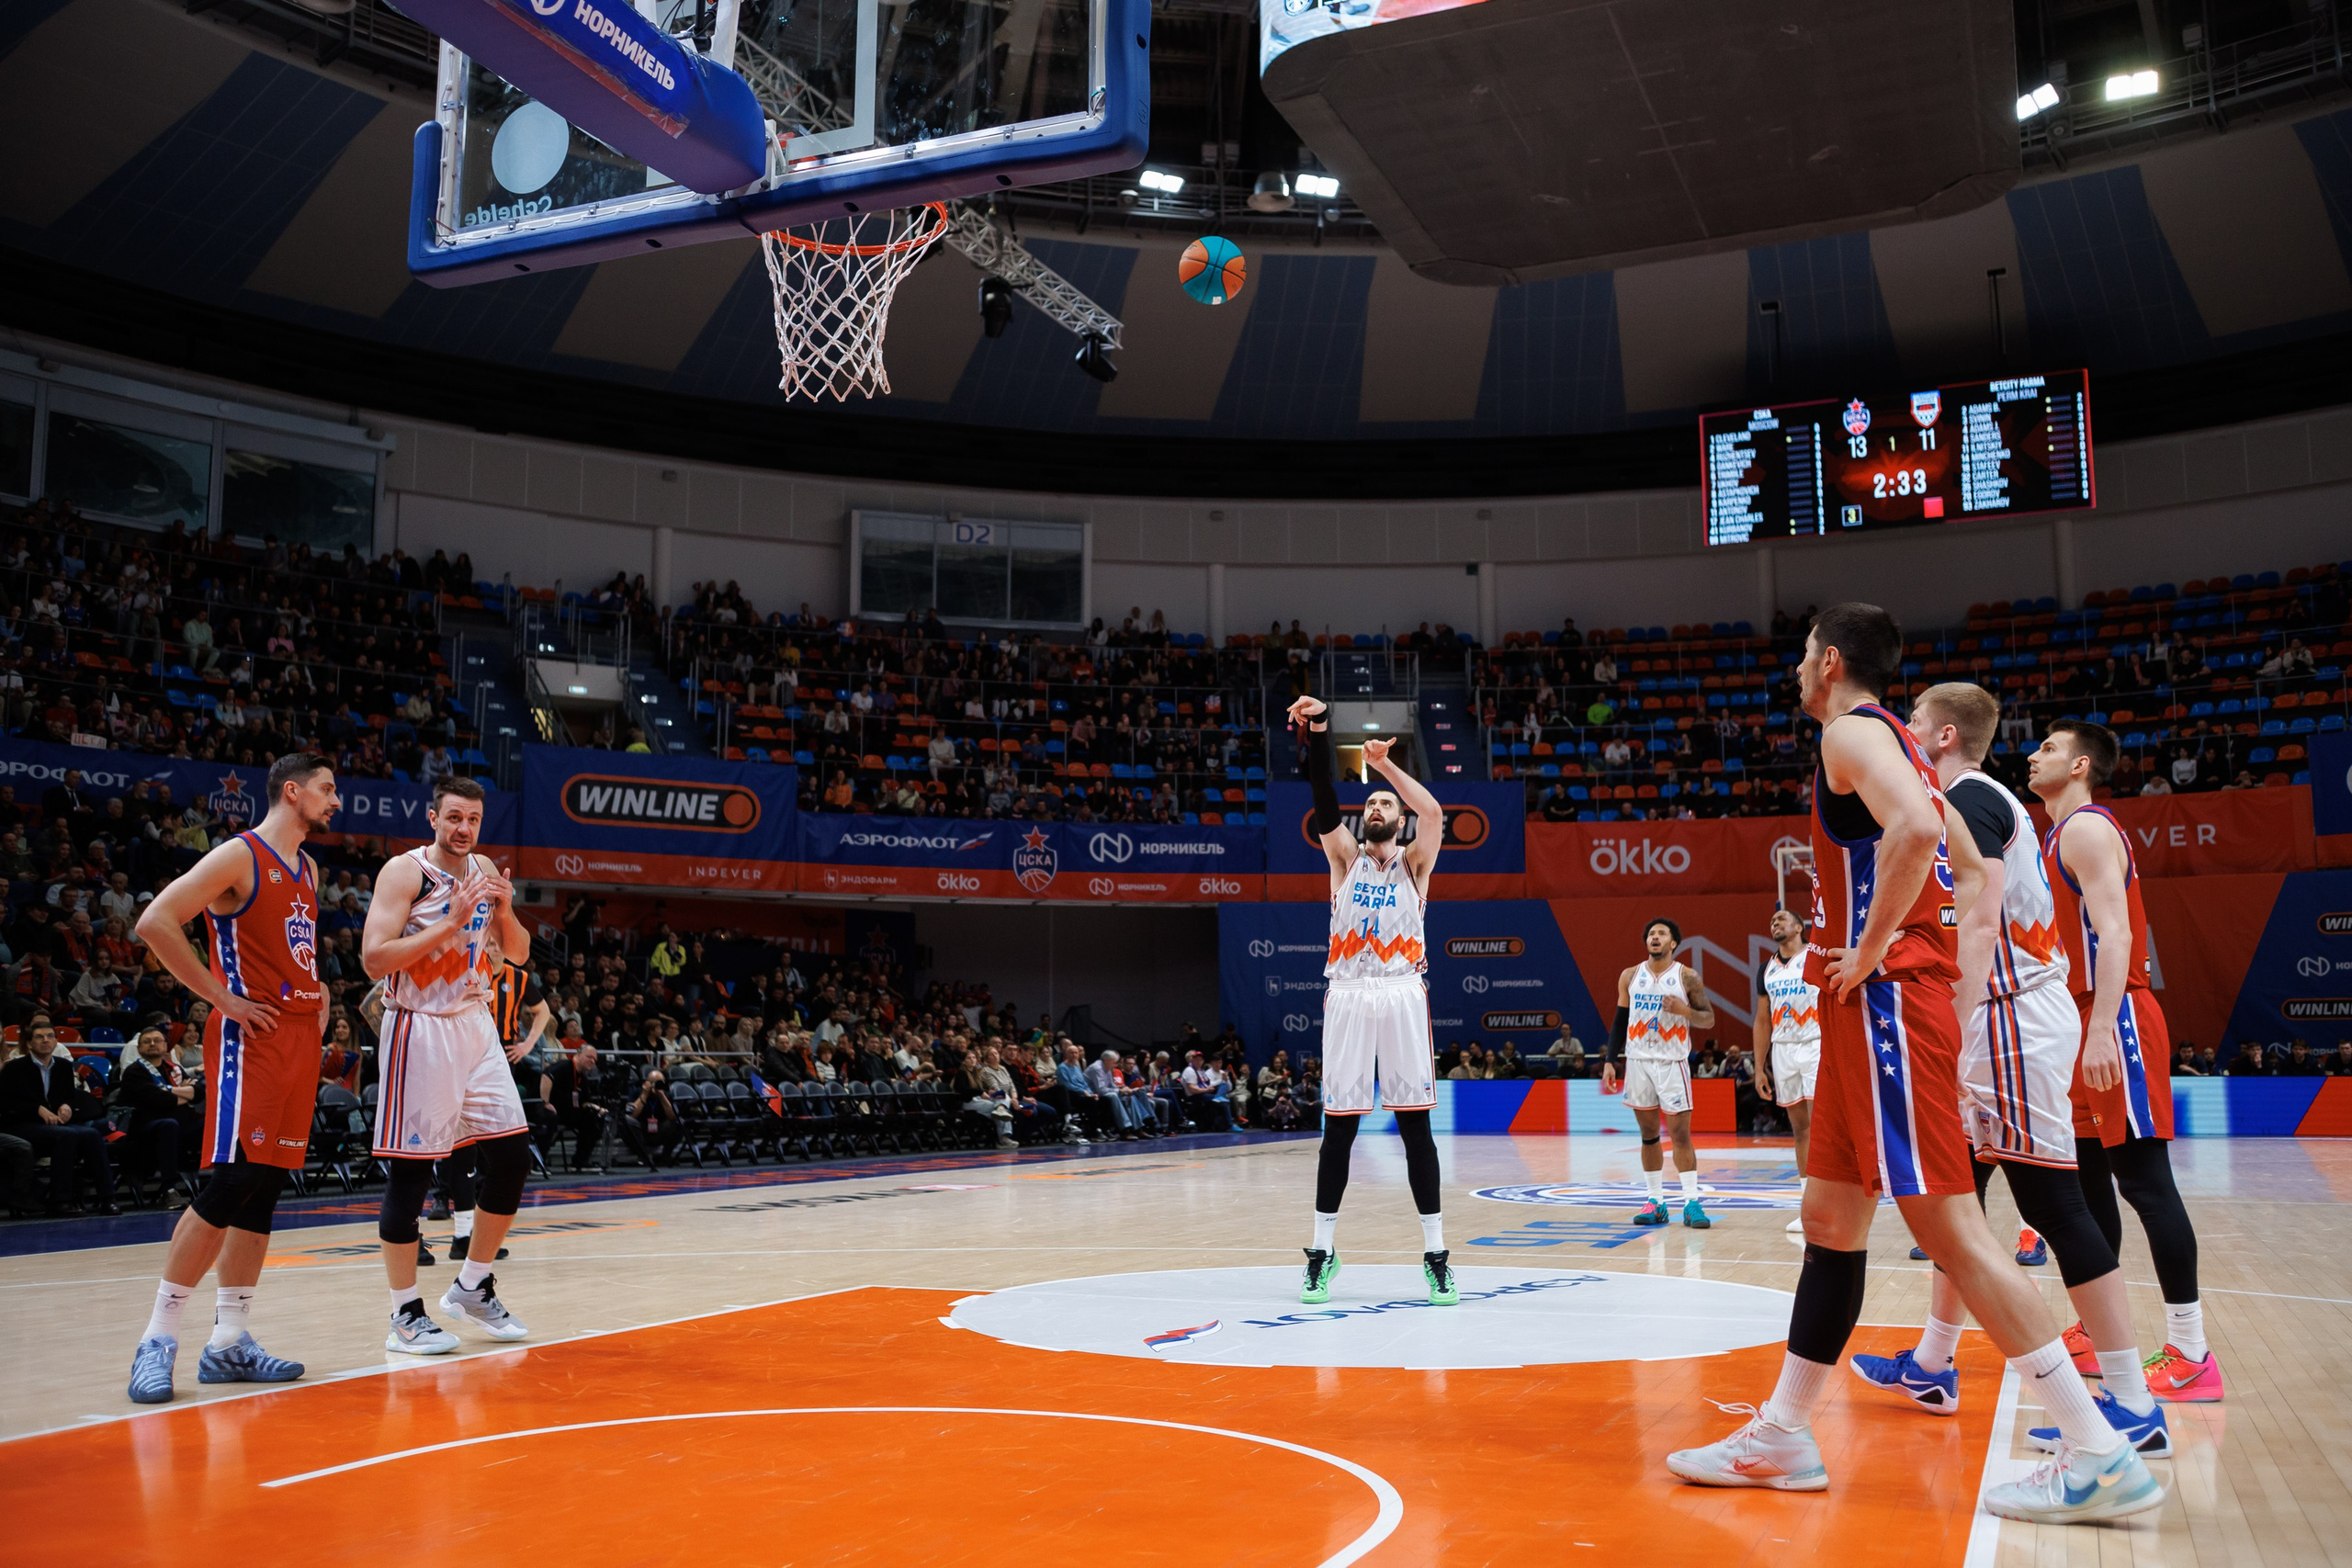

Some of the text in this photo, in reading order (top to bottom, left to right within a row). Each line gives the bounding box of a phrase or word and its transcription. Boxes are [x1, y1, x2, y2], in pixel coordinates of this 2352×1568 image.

[573, 0, 675, 90] НОРНИКЕЛЬ
[1848, 435, 1868, 458] 13
[1888, 435, 1895, 452] 1
[1918, 428, 1936, 451] 11
[1873, 468, 1927, 499] 2:33
[956, 524, 990, 545] D2
[579, 784, 719, 821] WINLINE
[840, 833, 959, 850] АЭРОФЛОТ
[1140, 843, 1225, 854] НОРНИКЕЛЬ
[588, 862, 642, 873] НОРНИКЕЛЬ
[1018, 853, 1052, 867] ЦСКА
[689, 866, 762, 880] INDEVER
[841, 874, 897, 885] ЭНДОФАРМ
[289, 925, 311, 940] CSKA
[1361, 916, 1380, 940] 14
[1452, 942, 1507, 953] WINLINE
[310, 958, 318, 982] 8
[1284, 982, 1329, 990] ЭНДОФА
[1781, 1001, 1792, 1019] 2
[1487, 1015, 1544, 1027] WINLINE
[1646, 1016, 1659, 1032] 4
